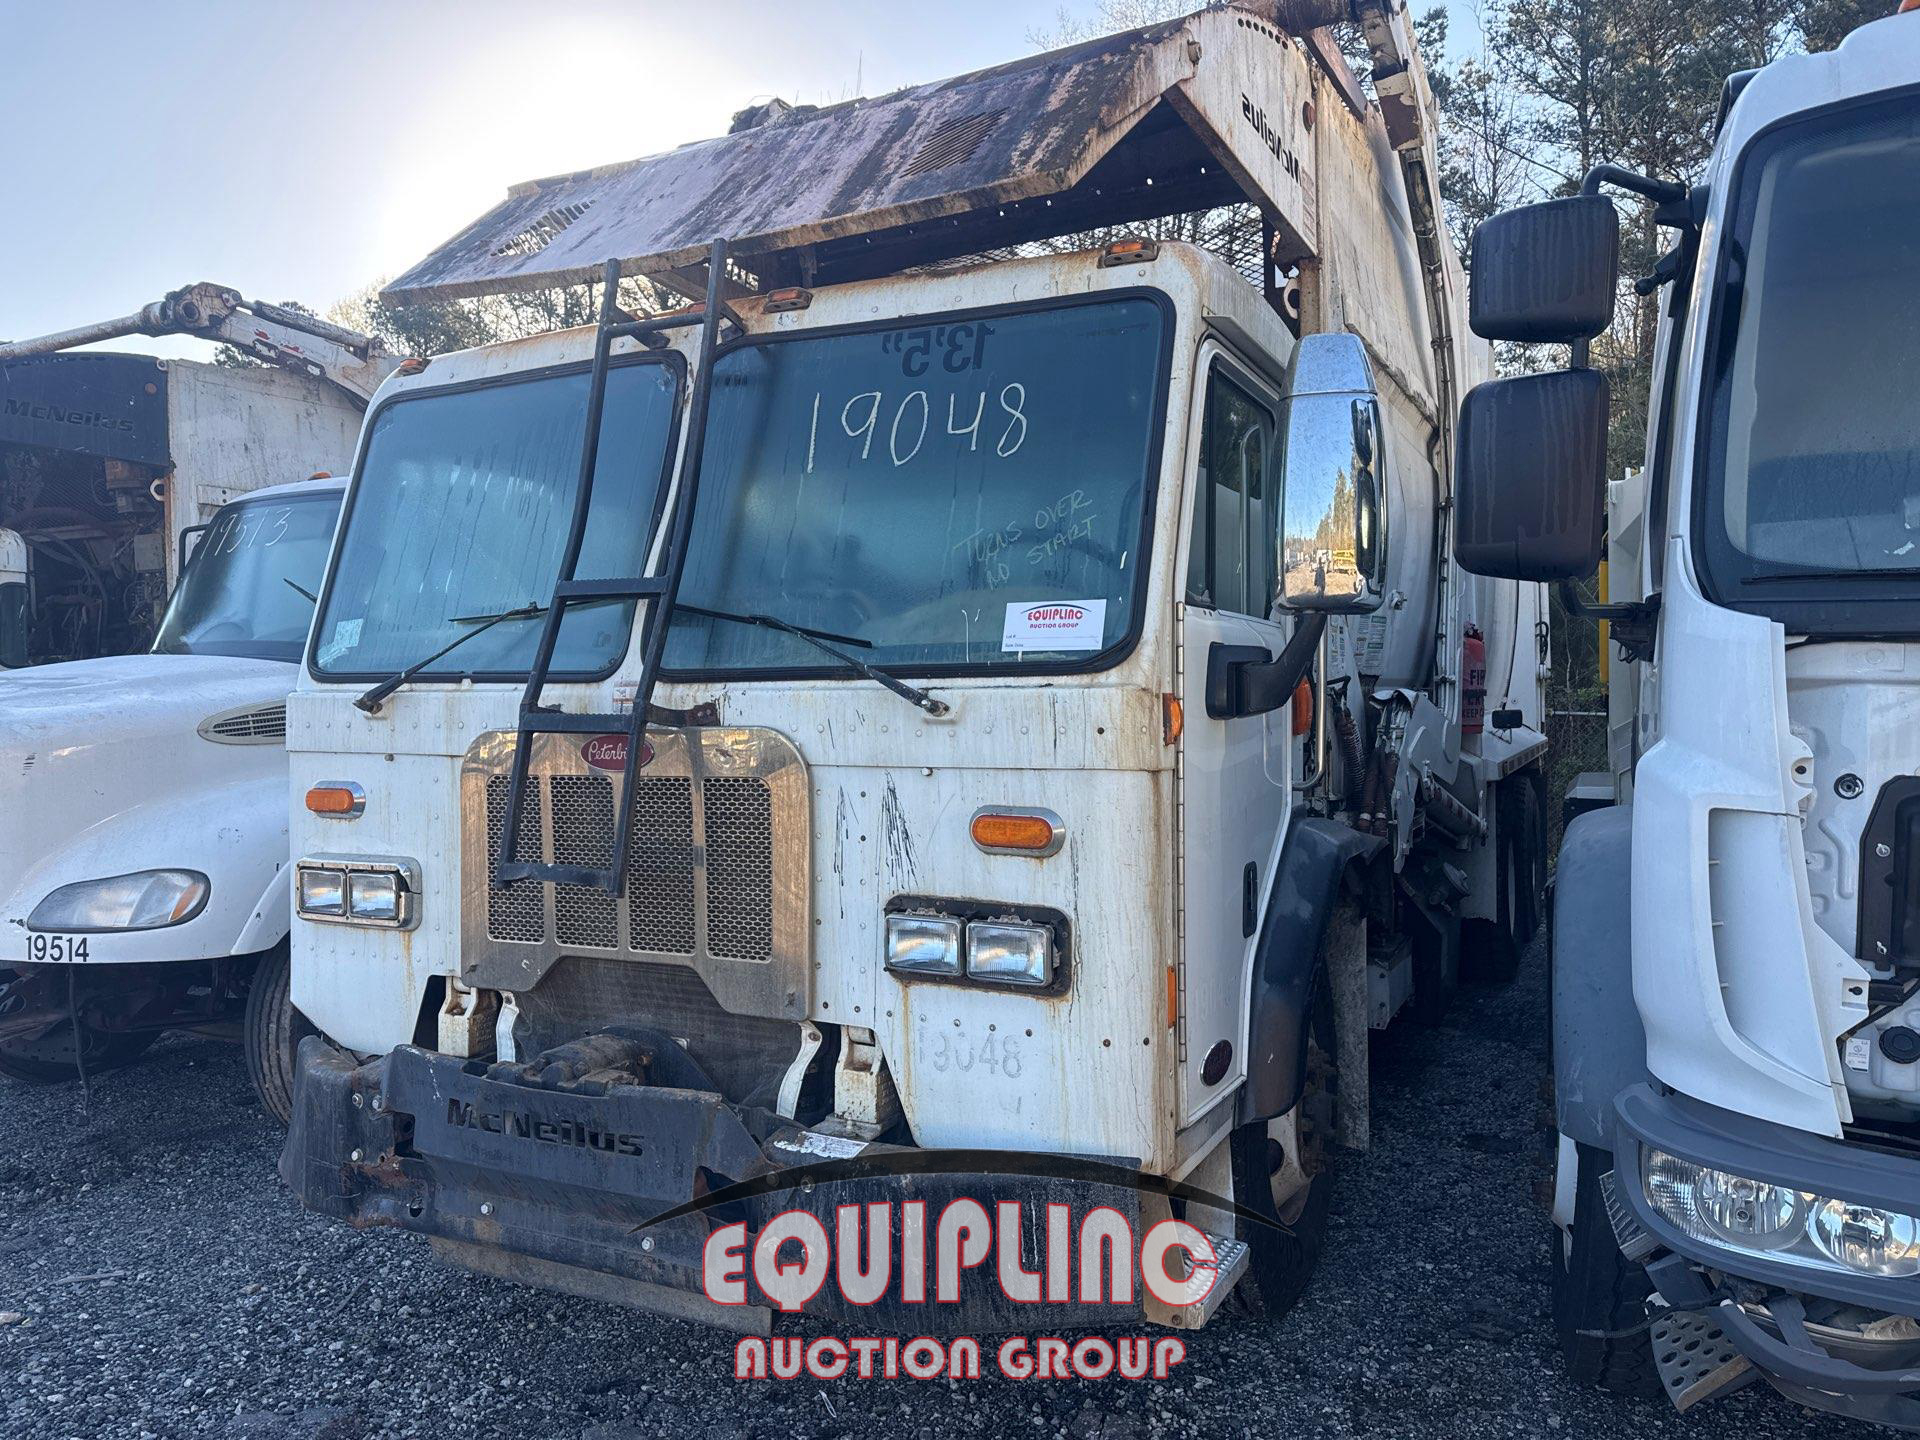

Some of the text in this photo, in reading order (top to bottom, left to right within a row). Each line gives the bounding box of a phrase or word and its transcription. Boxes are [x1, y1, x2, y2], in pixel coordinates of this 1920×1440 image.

[807, 383, 1028, 473] 19048
[200, 507, 294, 560] 19513
[1035, 489, 1093, 530] OVER
[1025, 514, 1097, 565] START
[26, 934, 89, 962] 19514
[447, 1098, 643, 1156] McNeilus
